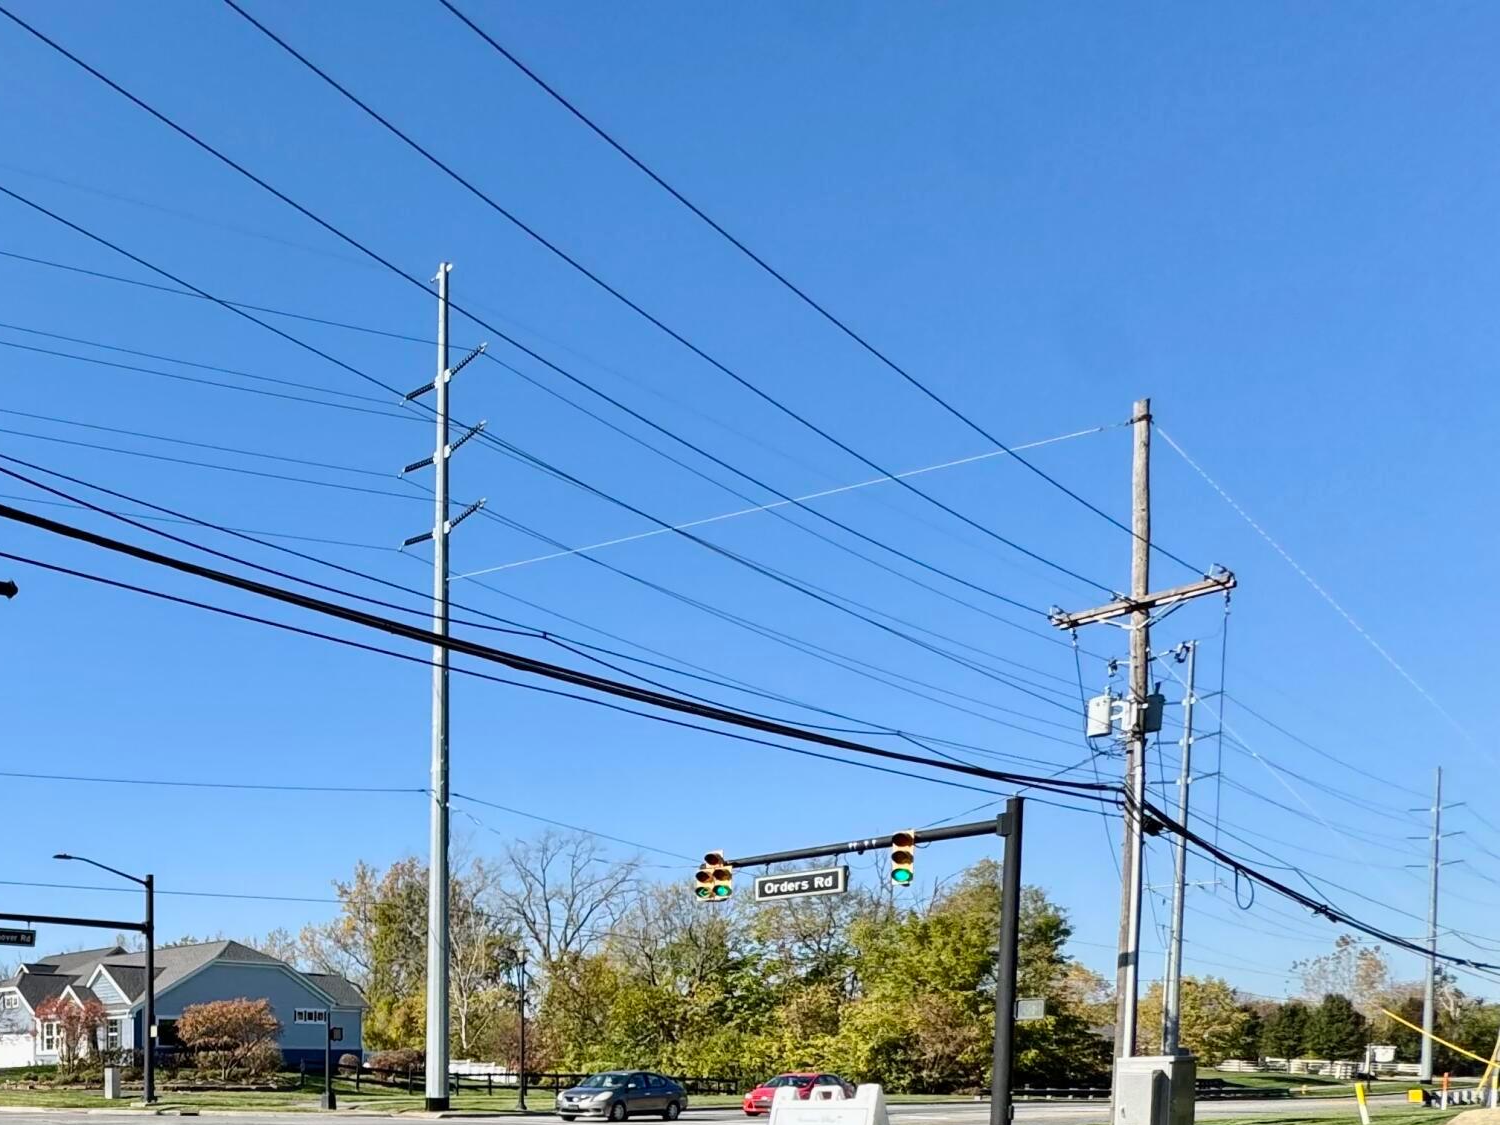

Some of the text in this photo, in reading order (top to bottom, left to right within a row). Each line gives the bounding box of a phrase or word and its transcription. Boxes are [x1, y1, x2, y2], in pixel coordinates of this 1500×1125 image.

[764, 876, 833, 894] Orders Rd
[20, 934, 31, 943] Rd
